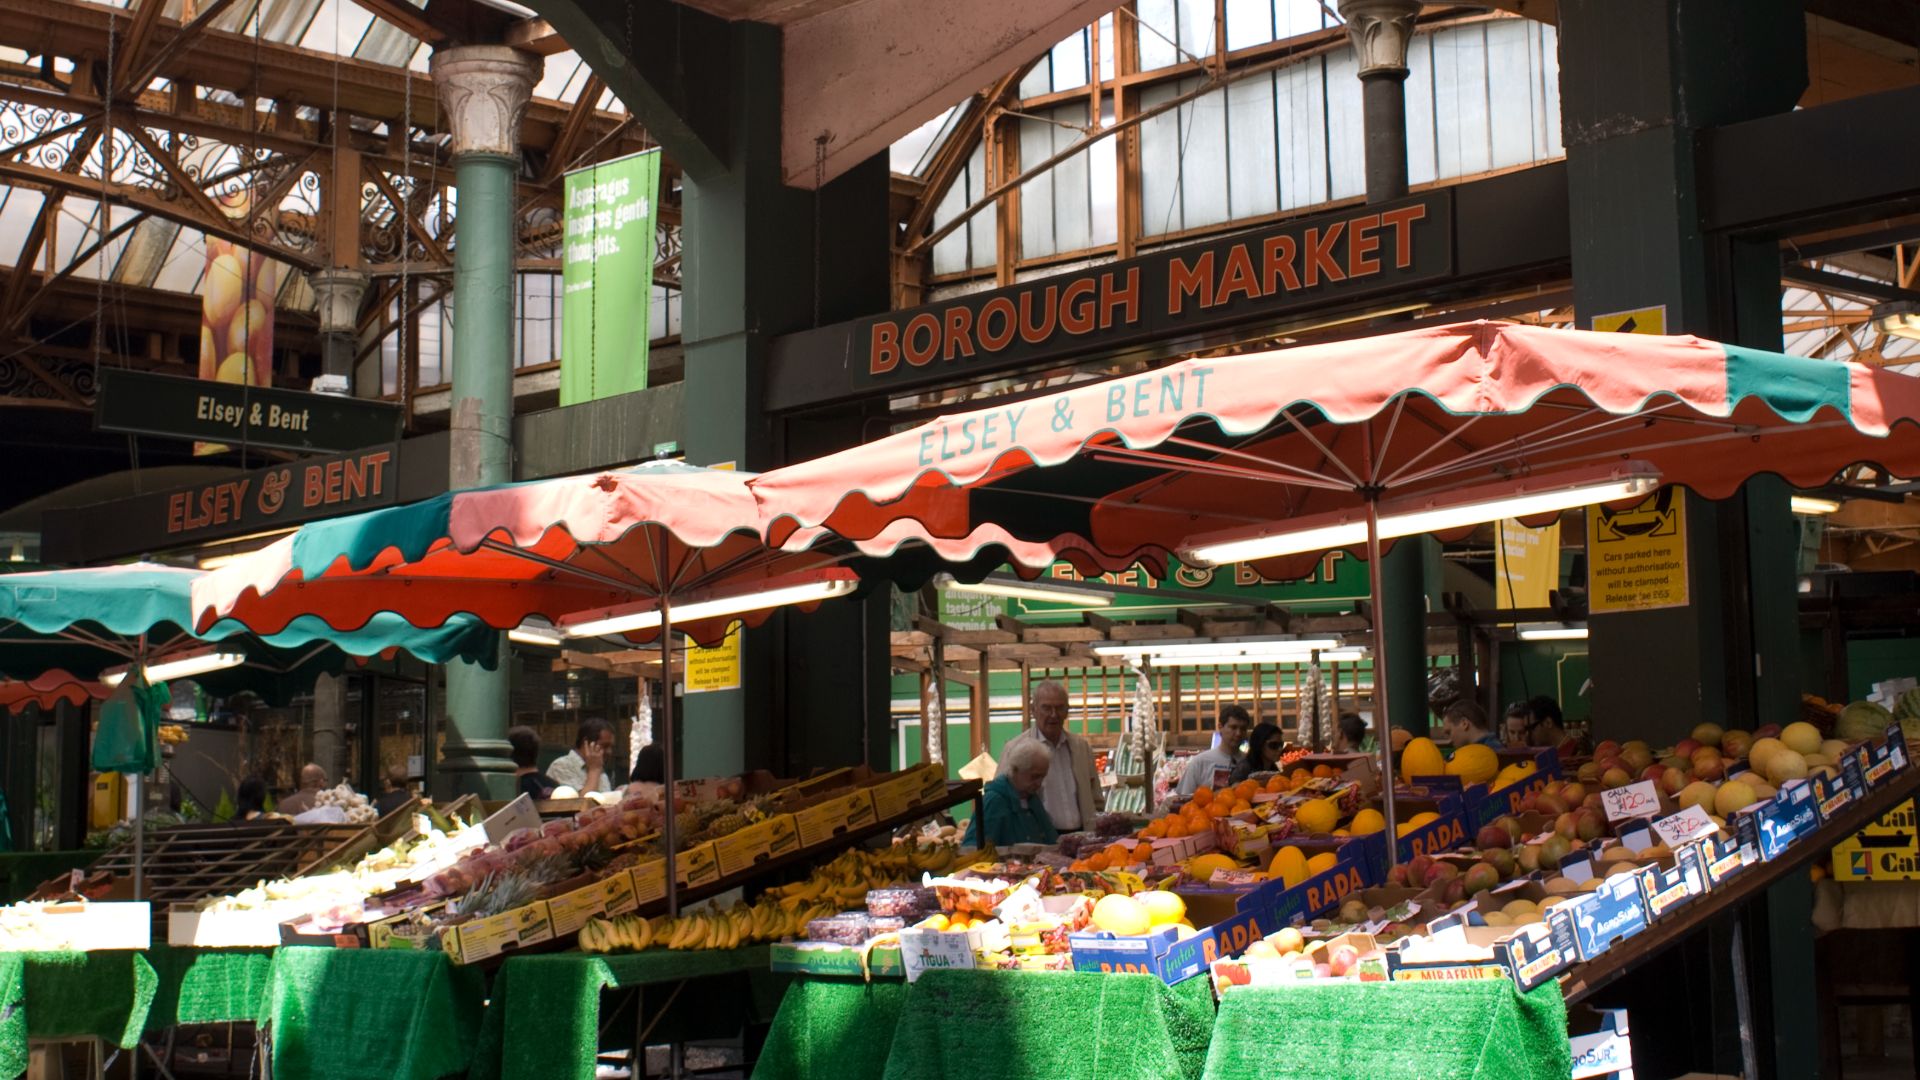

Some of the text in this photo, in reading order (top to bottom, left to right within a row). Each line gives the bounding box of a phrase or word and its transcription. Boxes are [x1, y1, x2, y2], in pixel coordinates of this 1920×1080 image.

[569, 177, 630, 210] Asparagus
[568, 208, 612, 238] inspires
[869, 203, 1427, 375] BOROUGH MARKET
[197, 396, 309, 432] Elsey & Bent
[918, 367, 1215, 467] ELSEY & BENT
[167, 450, 391, 533] ELSEY & BENT
[1234, 550, 1344, 586] BT
[1596, 560, 1680, 577] without authorisation
[1603, 547, 1671, 562] Cars parked here
[1607, 575, 1669, 590] will be clamped
[1411, 818, 1465, 857] RADA
[1306, 866, 1364, 912] RADA
[919, 953, 950, 967] TIGUA
[1164, 943, 1196, 978] frutas
[1202, 918, 1263, 965] RADA
